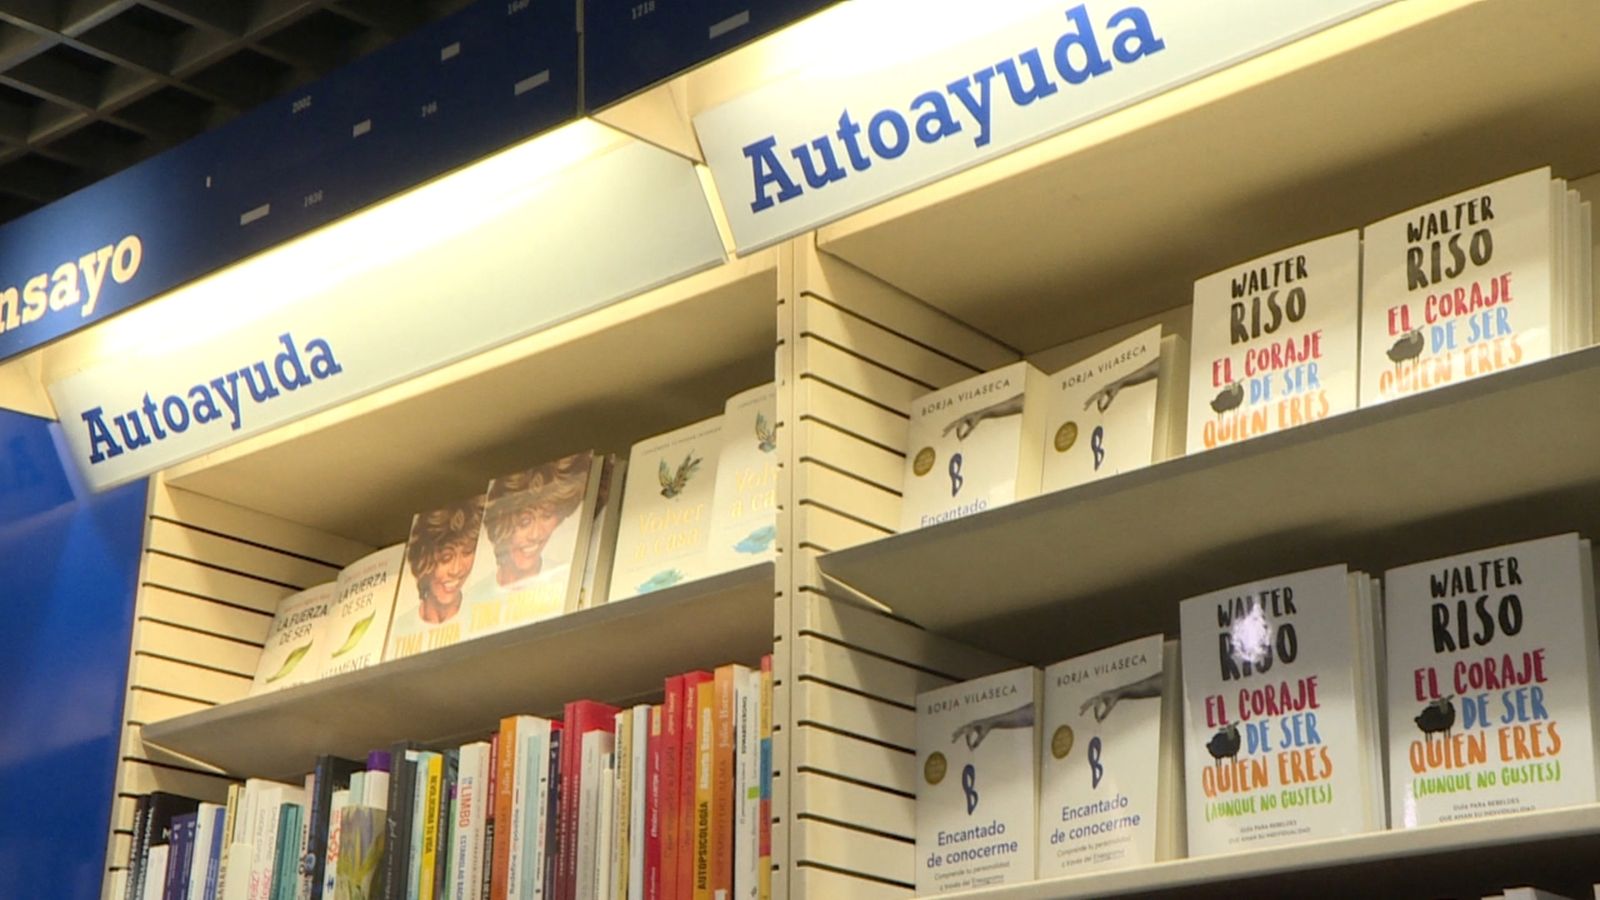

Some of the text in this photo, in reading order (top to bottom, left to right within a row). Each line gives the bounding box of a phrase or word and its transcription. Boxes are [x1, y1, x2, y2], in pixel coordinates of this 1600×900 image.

[743, 3, 1165, 213] Autoayuda
[1407, 195, 1495, 243] WALTER
[1231, 254, 1308, 299] WALTER
[1407, 228, 1494, 291] RISO
[0, 234, 142, 333] nsayo
[1388, 272, 1514, 336] EL CORAJE
[1230, 286, 1307, 345] RISO
[1431, 306, 1512, 354] DE SER
[1062, 344, 1147, 391] BORJA VILASECA
[1212, 329, 1324, 387] EL CORAJE
[1379, 334, 1523, 396] QUIEN ERES
[82, 333, 342, 464] Autoayuda
[921, 377, 1011, 417] BORJA VILASECA
[1250, 361, 1320, 405] DE SER
[1203, 389, 1330, 448] QUIEN ERES
[921, 498, 987, 528] Encantado
[349, 571, 387, 595] FUERZA
[1431, 556, 1522, 598] WALTER
[289, 604, 328, 628] FUERZA
[1217, 586, 1297, 629] WALTER
[1431, 594, 1523, 654] RISO
[1057, 653, 1147, 687] BORJA VILASECA
[1414, 647, 1548, 702] EL CORAJE
[927, 684, 1018, 716] BORJA VILASECA
[1205, 675, 1320, 728] EL CORAJE
[1461, 686, 1549, 730] DE SER
[1245, 712, 1321, 755] DE SER
[1409, 721, 1562, 774] QUIEN ERES
[1202, 746, 1333, 799] QUIEN ERES
[1413, 761, 1561, 799] (AUNQUE NO GUSTES)
[459, 784, 473, 828] LIMBO
[1062, 793, 1128, 822] Encantado
[1205, 783, 1332, 822] (AUNQUE NO GUSTES)
[697, 801, 709, 890] AUTOPSICOLOGÍA
[938, 819, 1005, 846] Encantado
[1050, 814, 1141, 845] de conocerme
[927, 841, 1018, 868] de conocerme
